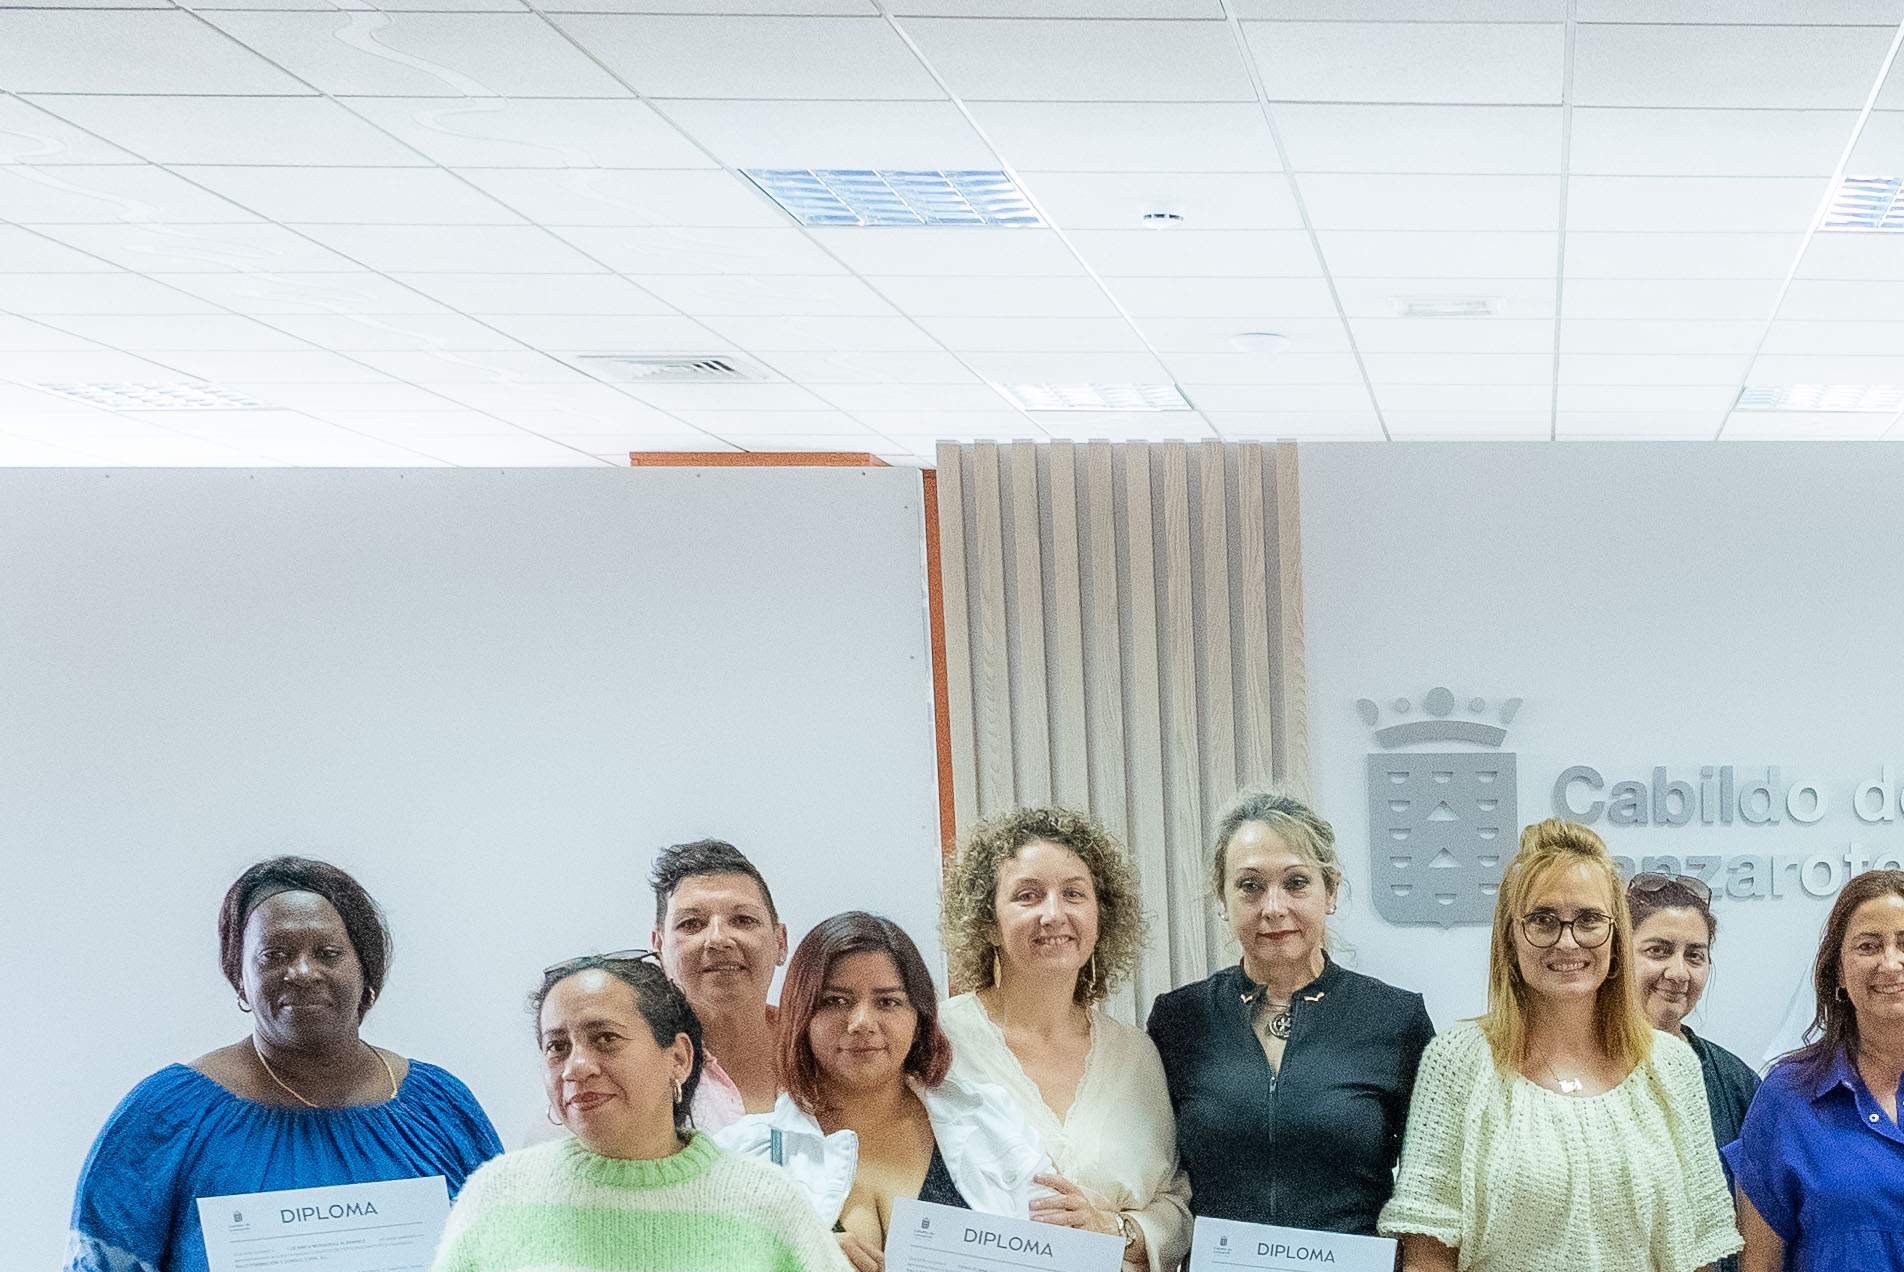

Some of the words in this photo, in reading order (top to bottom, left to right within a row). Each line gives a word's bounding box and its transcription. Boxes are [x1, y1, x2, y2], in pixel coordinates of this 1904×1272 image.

[1552, 764, 1826, 829] Cabildo
[280, 1201, 379, 1224] DIPLOMA
[963, 1227, 1054, 1258] DIPLOMA
[1257, 1242, 1336, 1264] DIPLOMA
